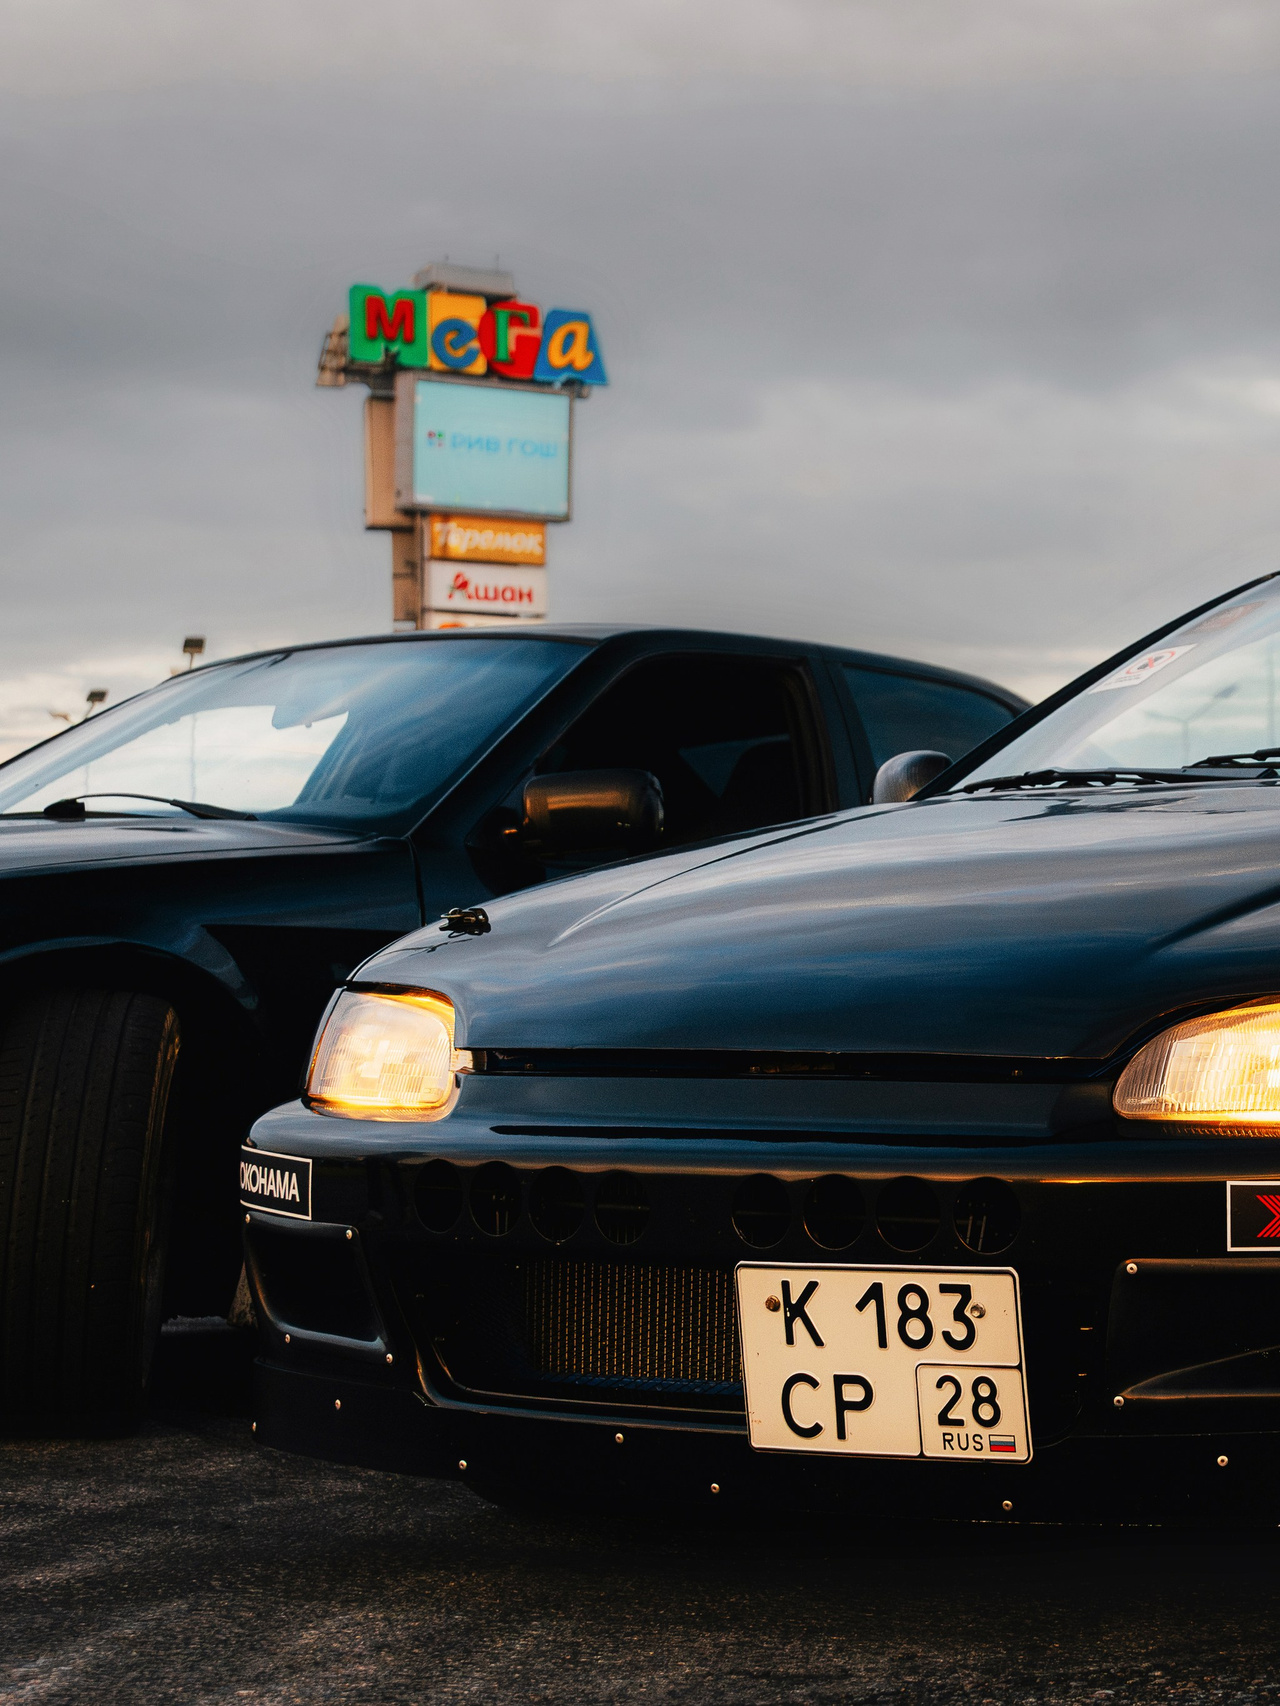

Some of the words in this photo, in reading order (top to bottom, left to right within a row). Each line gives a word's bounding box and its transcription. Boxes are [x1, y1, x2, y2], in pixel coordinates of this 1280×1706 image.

[448, 572, 534, 604] Ашан
[240, 1161, 300, 1202] OKOHAMA
[855, 1281, 977, 1351] 183
[936, 1375, 1001, 1428] 28
[942, 1432, 984, 1452] RUS
